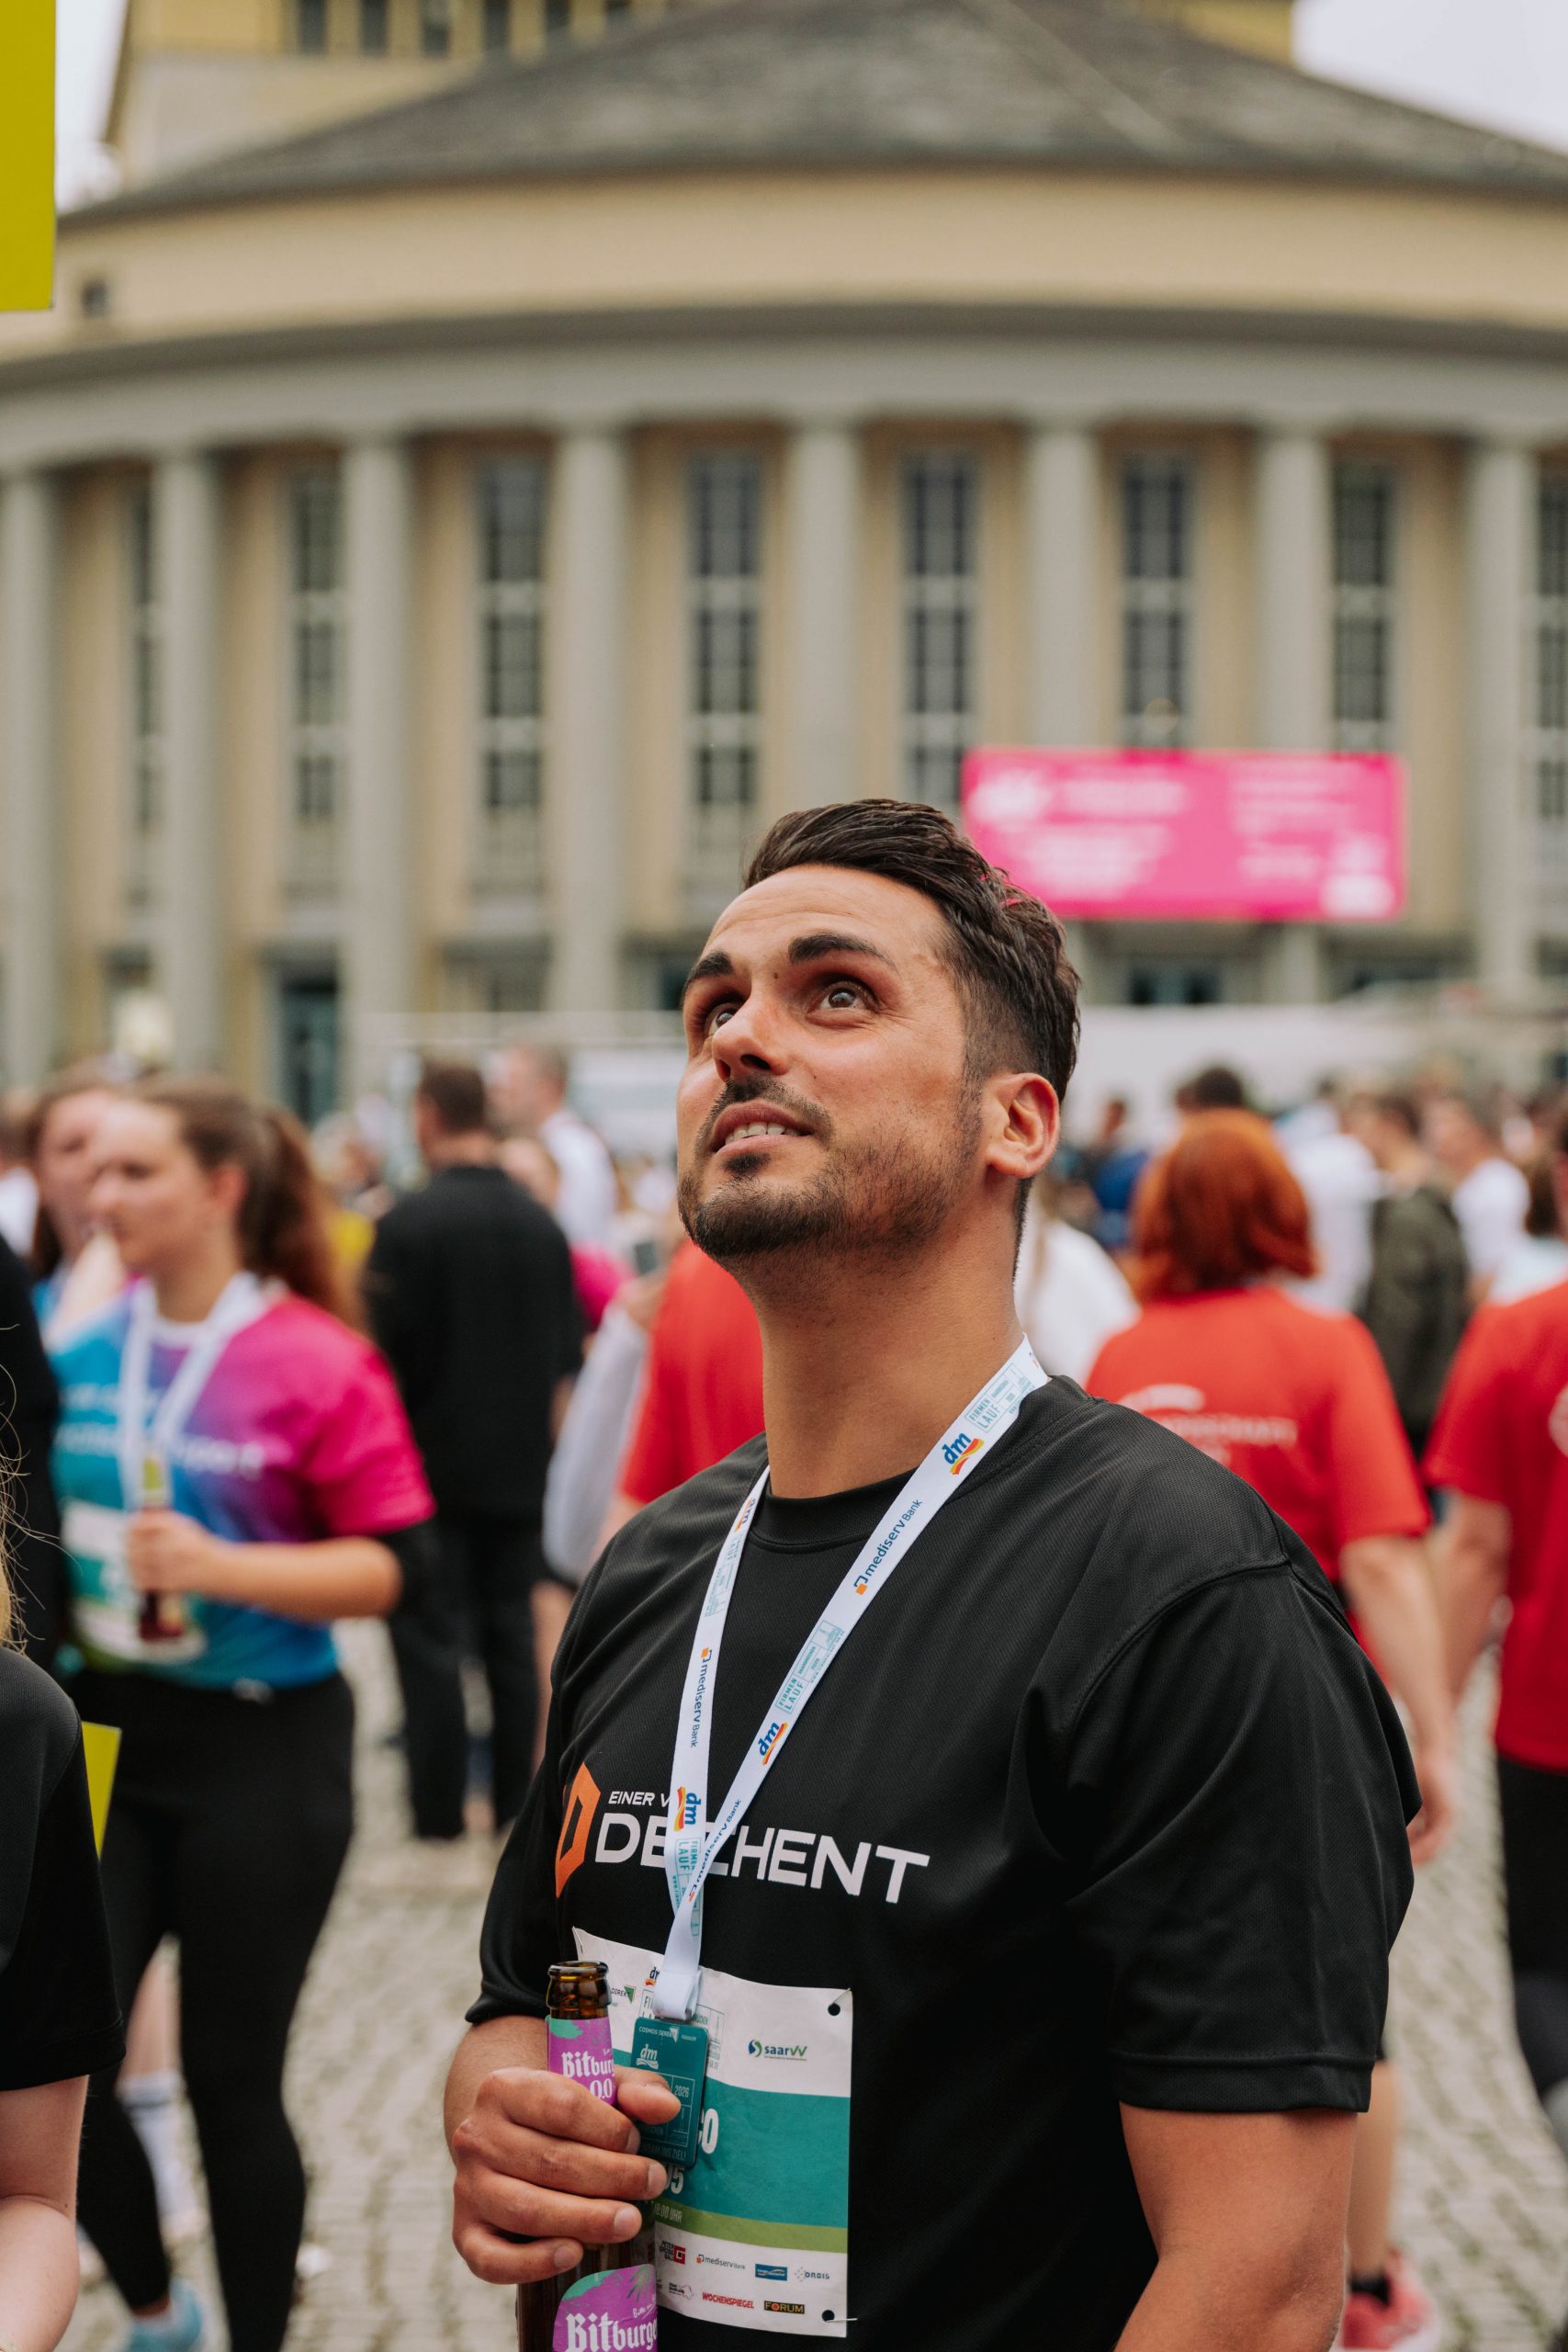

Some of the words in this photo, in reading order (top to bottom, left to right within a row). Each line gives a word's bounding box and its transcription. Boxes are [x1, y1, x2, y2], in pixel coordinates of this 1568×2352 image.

[977, 1404, 1000, 1428] LAUF
[943, 1433, 971, 1464] dm
[865, 1520, 906, 1577] mediserv
[902, 1499, 923, 1521] Bank
[694, 1664, 708, 1724] mediserv
[778, 1677, 798, 1706] FIRMEN
[784, 1680, 805, 1711] LAUF
[690, 1724, 701, 1748] Bank
[759, 1722, 780, 1756] dm
[608, 1791, 656, 1805] EINER
[684, 1792, 702, 1826] dm
[726, 1798, 741, 1824] Bank
[678, 1841, 689, 1871] LAUF
[638, 2026, 659, 2035] COSMOS
[640, 2043, 659, 2061] dm
[675, 2085, 690, 2098] 2026
[705, 2256, 733, 2268] mediserv
[805, 2271, 830, 2279] ORBIS
[702, 2292, 755, 2309] WOCHENSPIEGEL
[765, 2301, 804, 2313] FORUM
